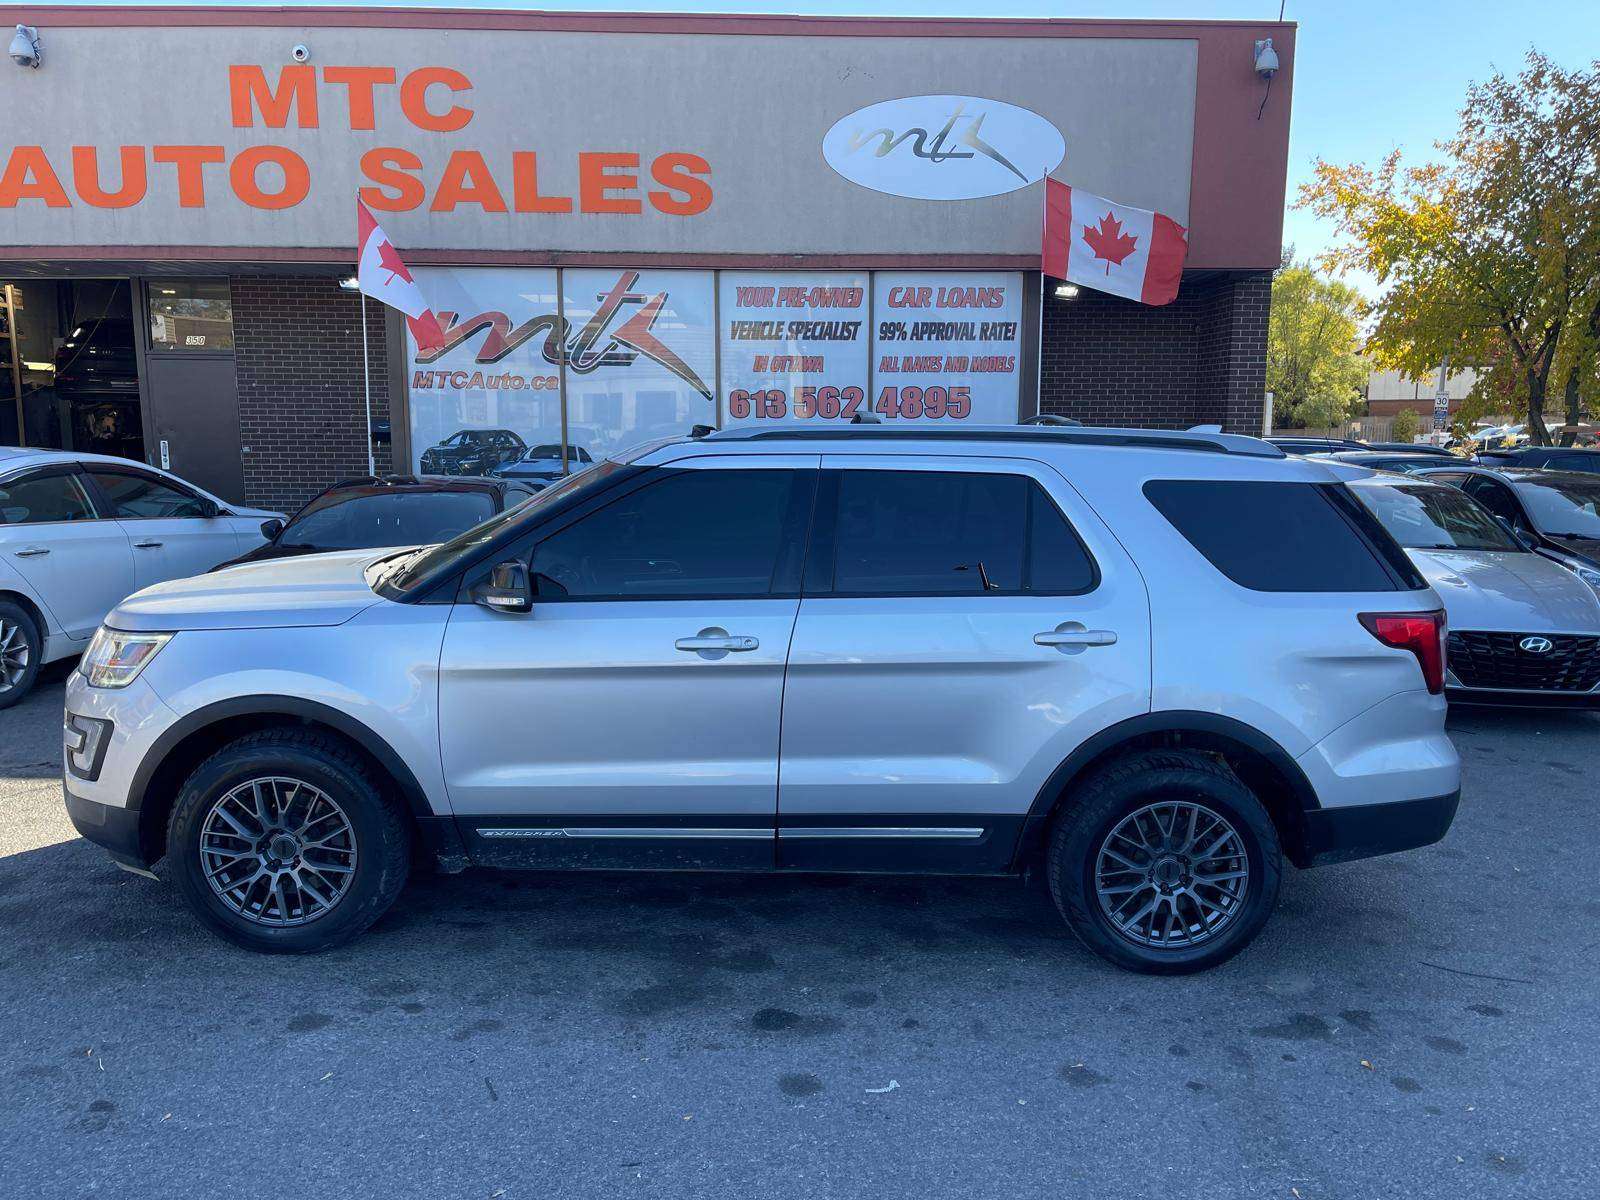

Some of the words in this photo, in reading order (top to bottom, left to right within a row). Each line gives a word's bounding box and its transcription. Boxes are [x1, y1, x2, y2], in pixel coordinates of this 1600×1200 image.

[229, 65, 475, 132] MTC
[0, 145, 311, 210] AUTO
[359, 147, 714, 216] SALES
[736, 287, 776, 308] YOUR
[776, 287, 864, 308] PRE-OWNED
[888, 287, 932, 308] CAR
[936, 287, 1006, 308] LOANS
[186, 335, 206, 346] 350
[730, 320, 786, 341] VEHICLE
[785, 320, 863, 341] SPECIALIST
[879, 321, 908, 341] 99%
[909, 321, 977, 341] APPROVAL
[979, 321, 1018, 341] RATE!
[752, 355, 769, 373] IN
[770, 355, 825, 373] OTTAWA
[879, 356, 900, 373] ALL
[900, 356, 943, 373] MAKES
[943, 356, 970, 373] AND
[970, 356, 1016, 373] MODELS
[412, 370, 560, 391] MTCAuto.ca
[729, 388, 788, 420] 613
[793, 386, 865, 420] 562
[875, 386, 972, 420] 4895
[1436, 397, 1447, 405] 30
